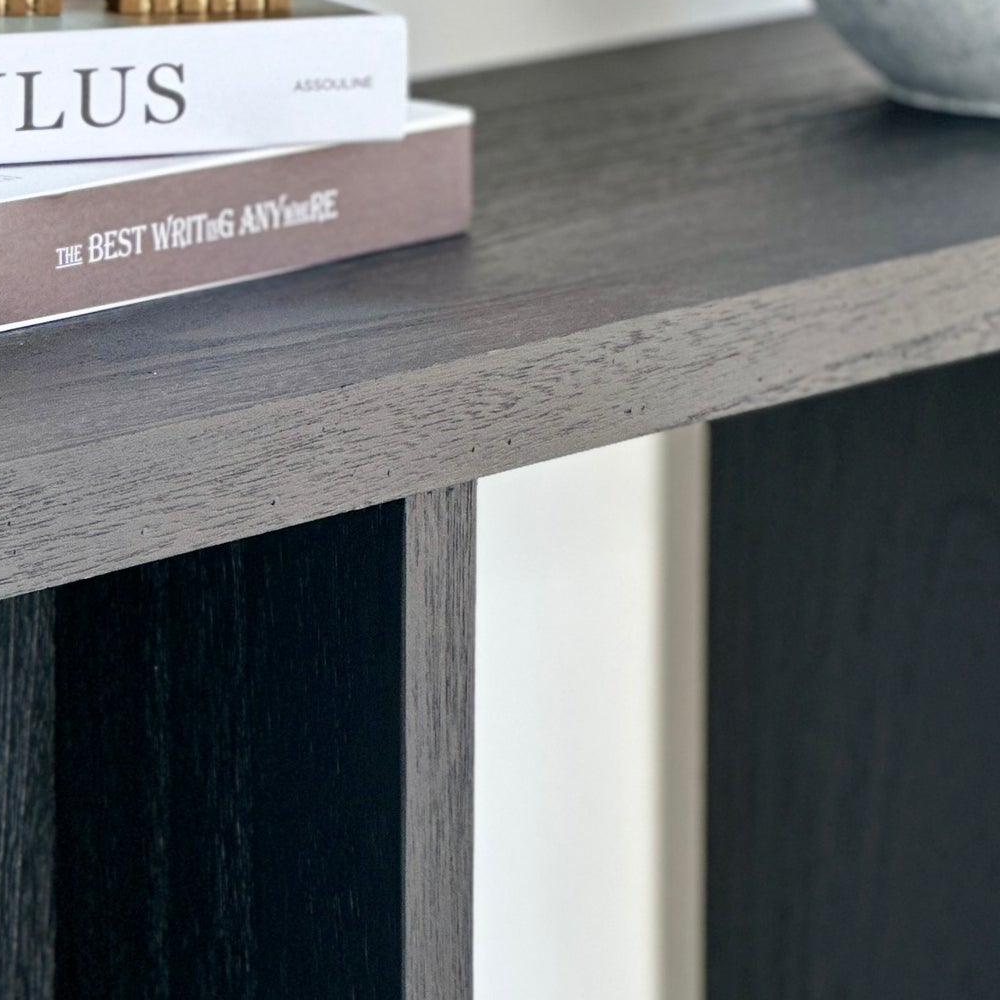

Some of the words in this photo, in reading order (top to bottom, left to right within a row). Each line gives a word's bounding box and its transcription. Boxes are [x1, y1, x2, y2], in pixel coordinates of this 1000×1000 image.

[294, 75, 372, 92] ASSOULINE
[55, 244, 83, 267] THE
[88, 225, 147, 263] BEST
